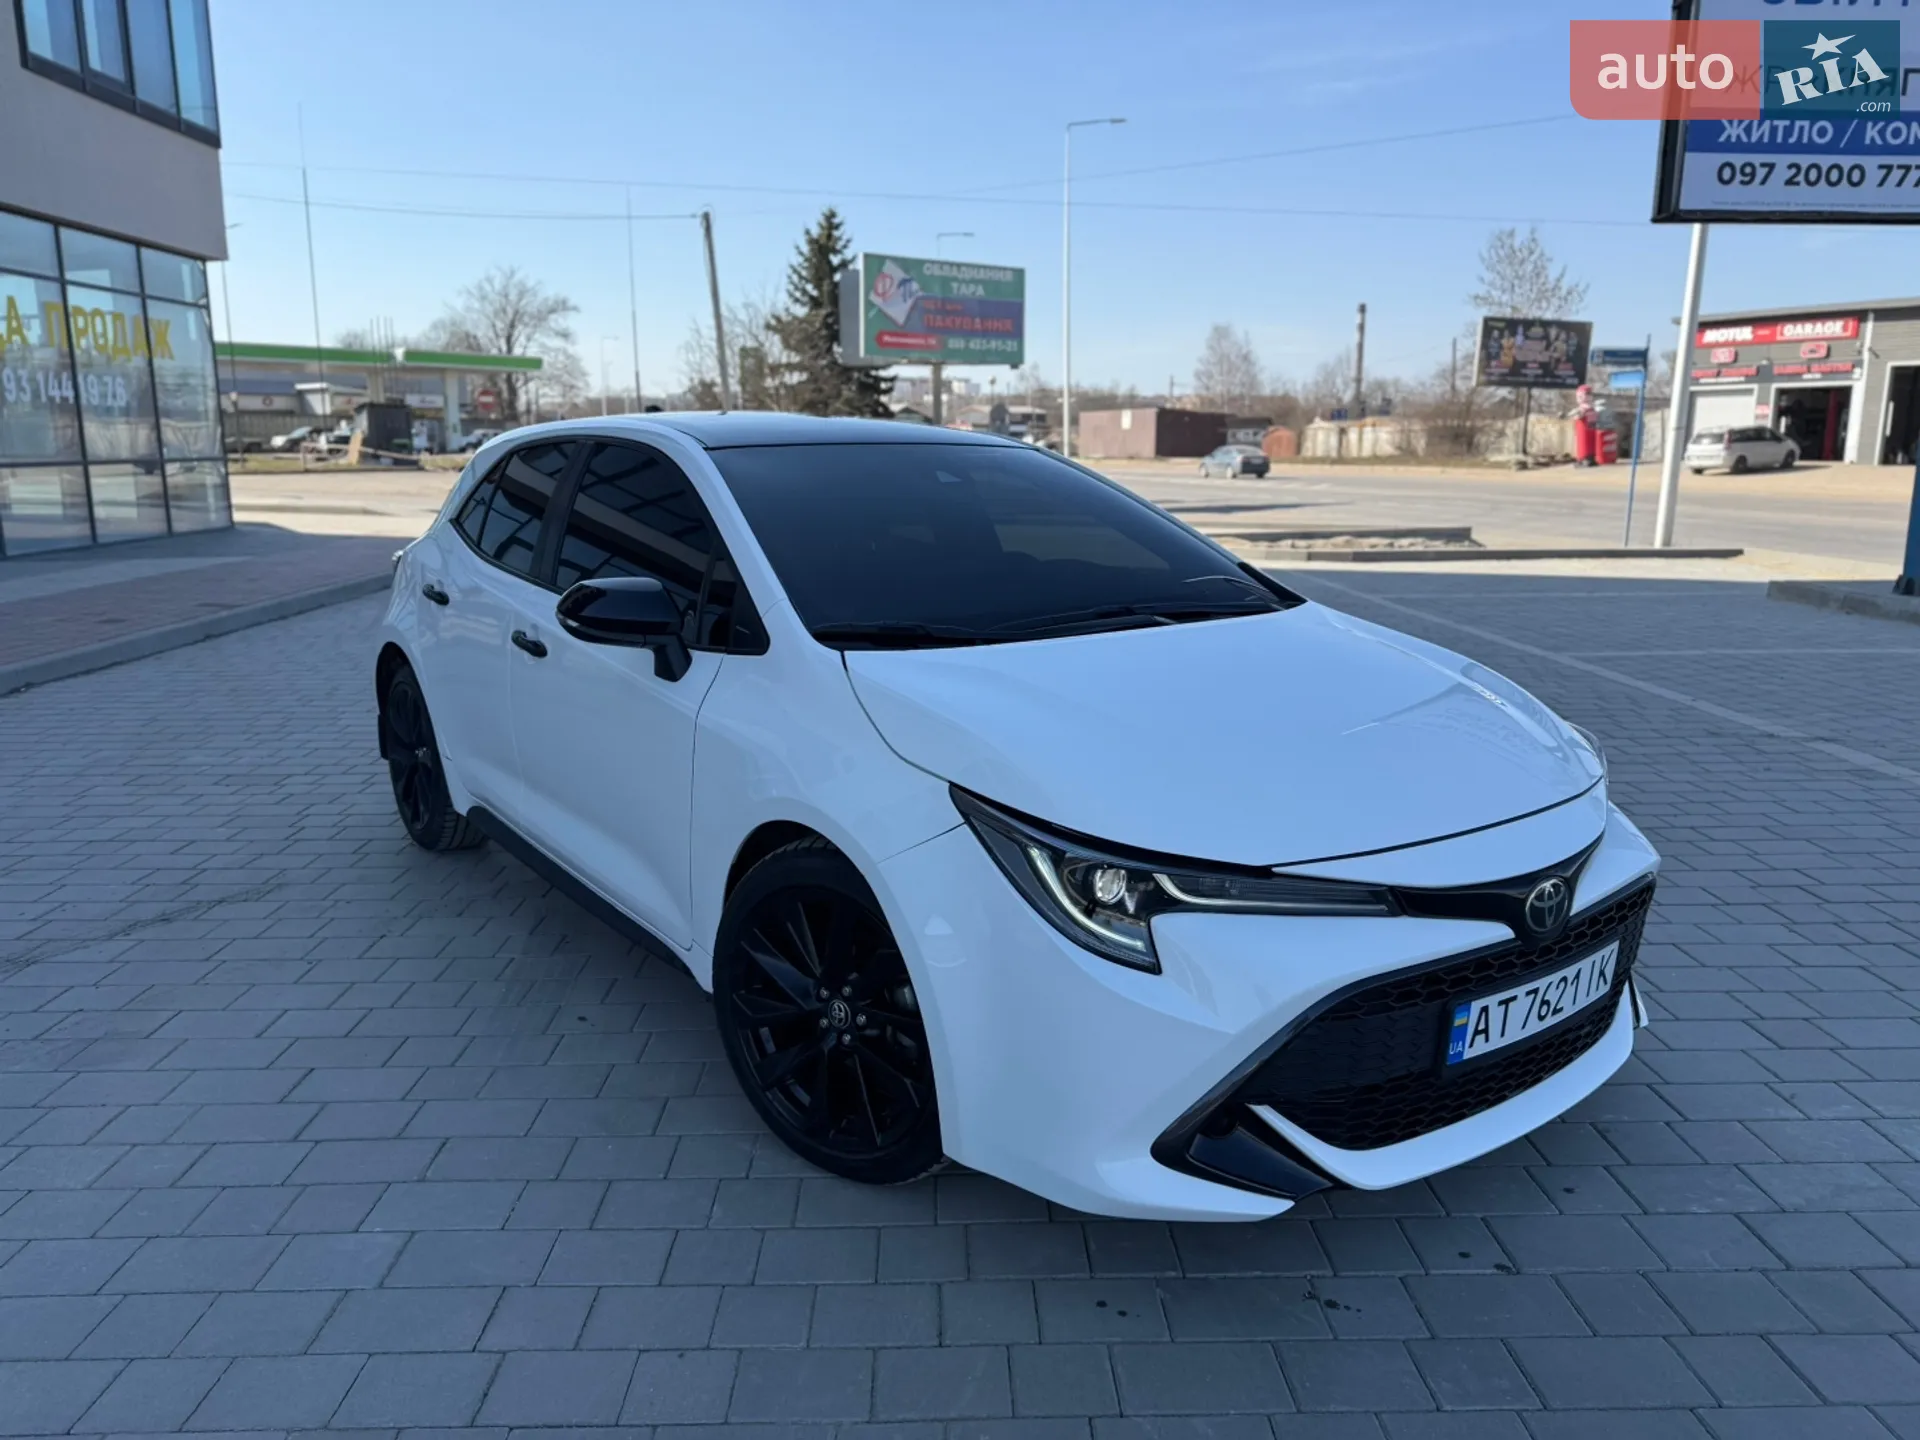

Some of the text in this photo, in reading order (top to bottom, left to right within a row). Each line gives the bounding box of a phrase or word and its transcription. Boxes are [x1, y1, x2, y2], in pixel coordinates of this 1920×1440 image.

[1718, 119, 1834, 144] ЖИТЛО
[1717, 161, 1776, 186] 097
[1784, 162, 1866, 188] 2000
[951, 281, 985, 297] ТАРА
[46, 302, 174, 361] ПРОДАЖ
[1703, 320, 1845, 343] MOTUL GARAGE
[1468, 948, 1615, 1049] AT 7621 IK
[1449, 1042, 1464, 1055] UA
